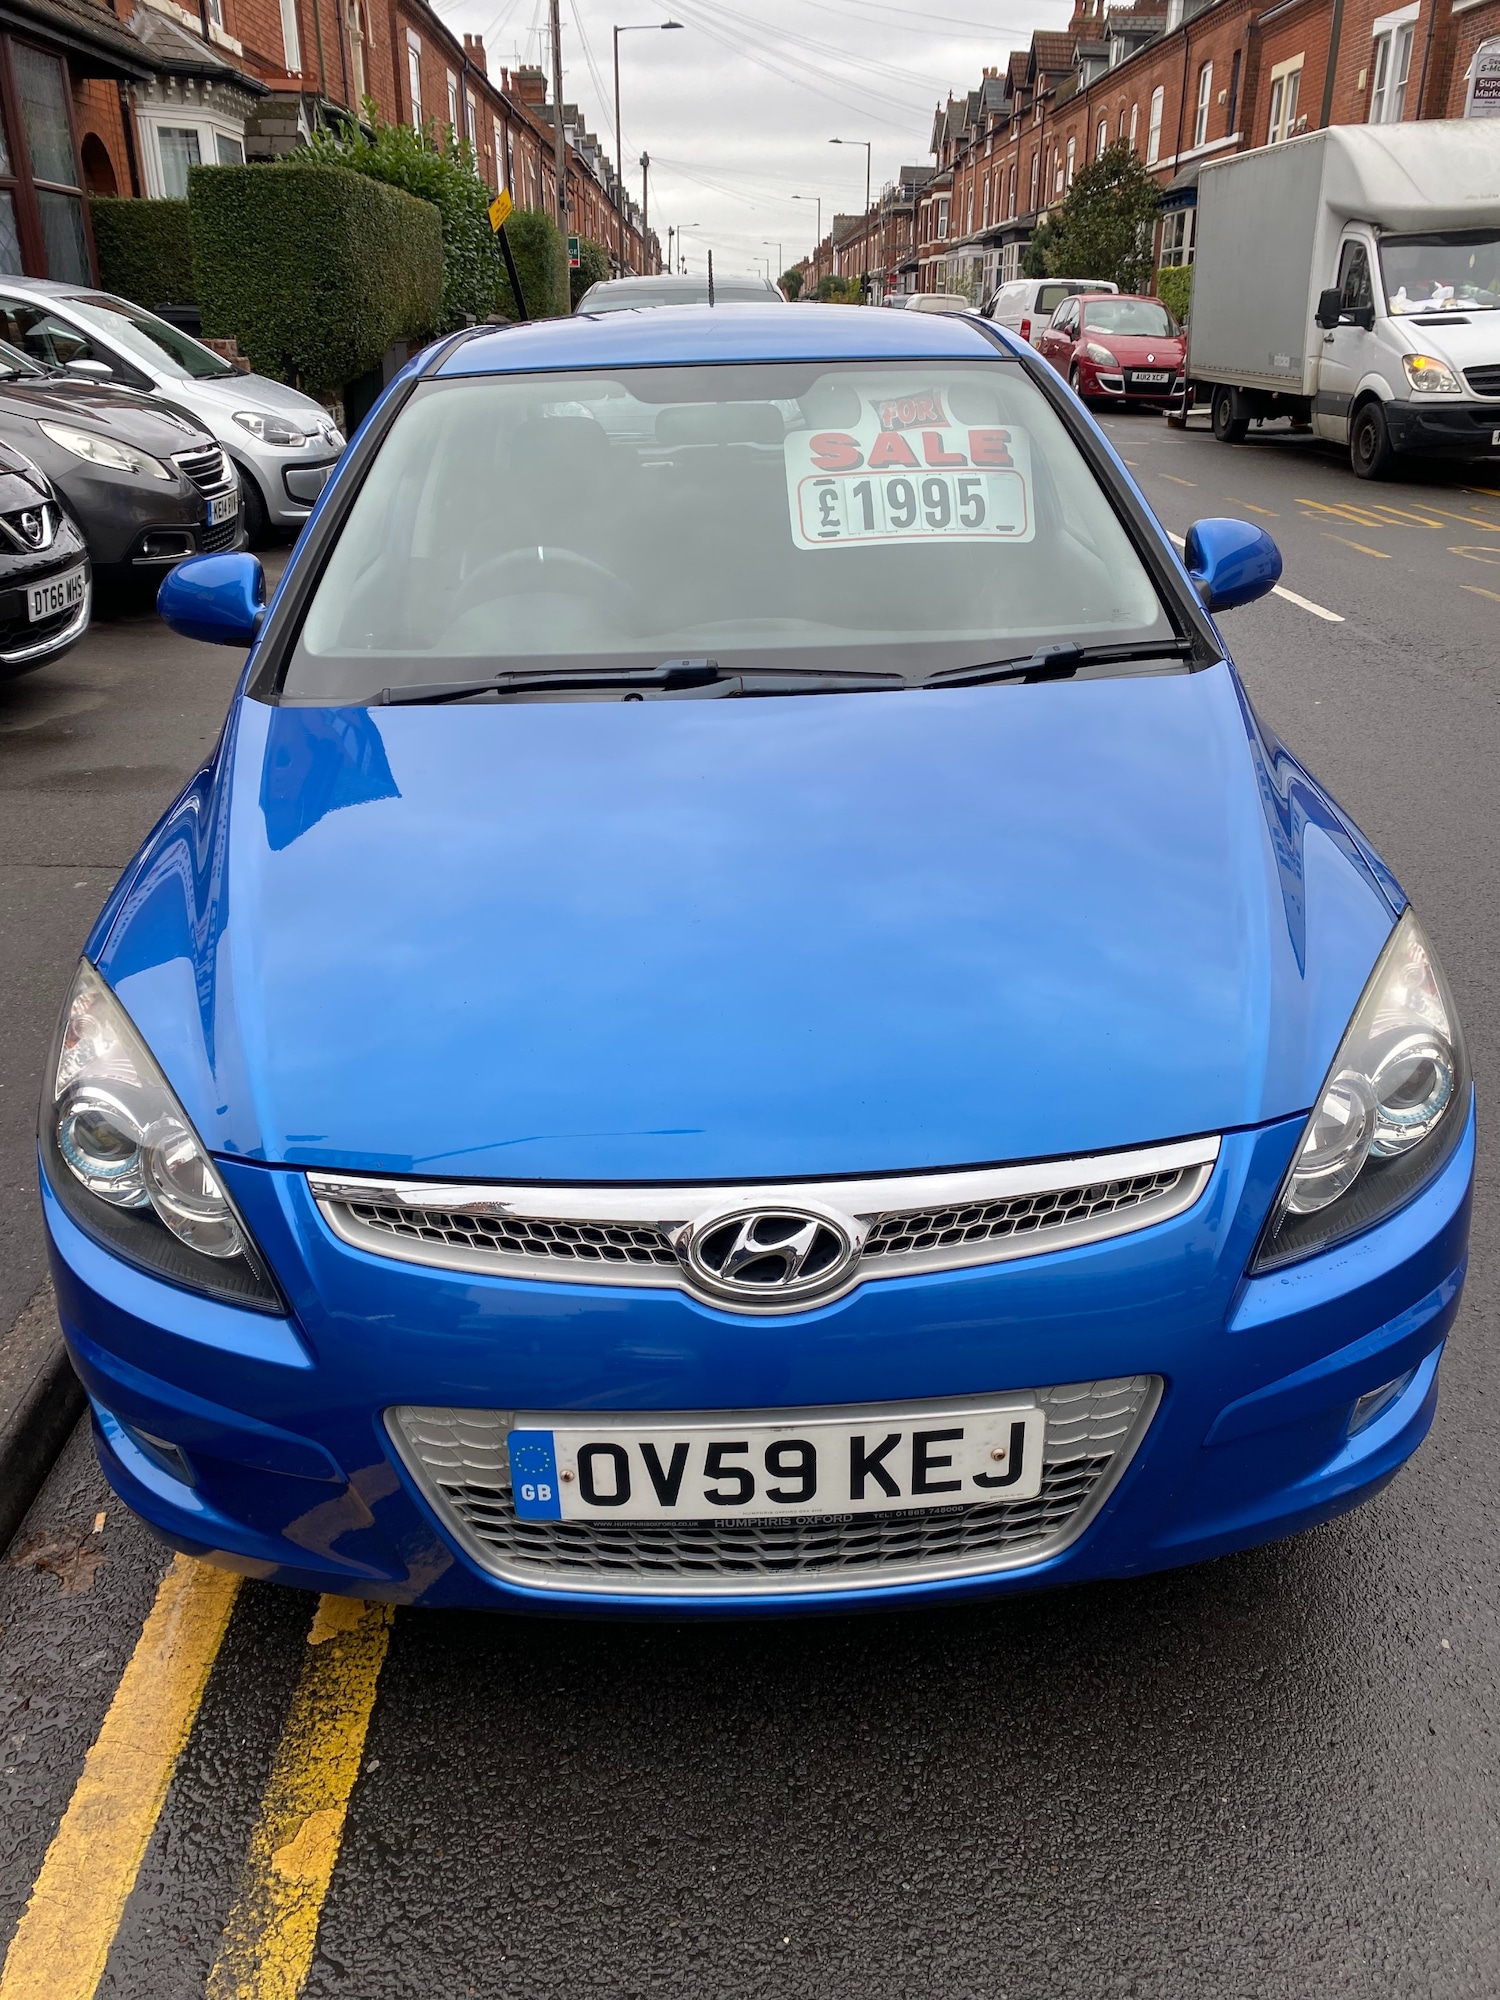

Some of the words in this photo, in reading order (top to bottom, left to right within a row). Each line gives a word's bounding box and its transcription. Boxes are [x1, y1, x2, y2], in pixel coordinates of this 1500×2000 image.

[879, 396, 938, 428] FOR
[809, 429, 1014, 472] SALE
[818, 477, 986, 531] £1995
[34, 583, 63, 616] DT66
[66, 574, 83, 603] WHS
[521, 1484, 552, 1501] GB
[576, 1439, 818, 1507] OV59
[849, 1421, 1026, 1500] KEJ
[714, 1516, 792, 1528] HUMPHRIS
[795, 1514, 854, 1525] OXFORD
[895, 1509, 926, 1517] 01865
